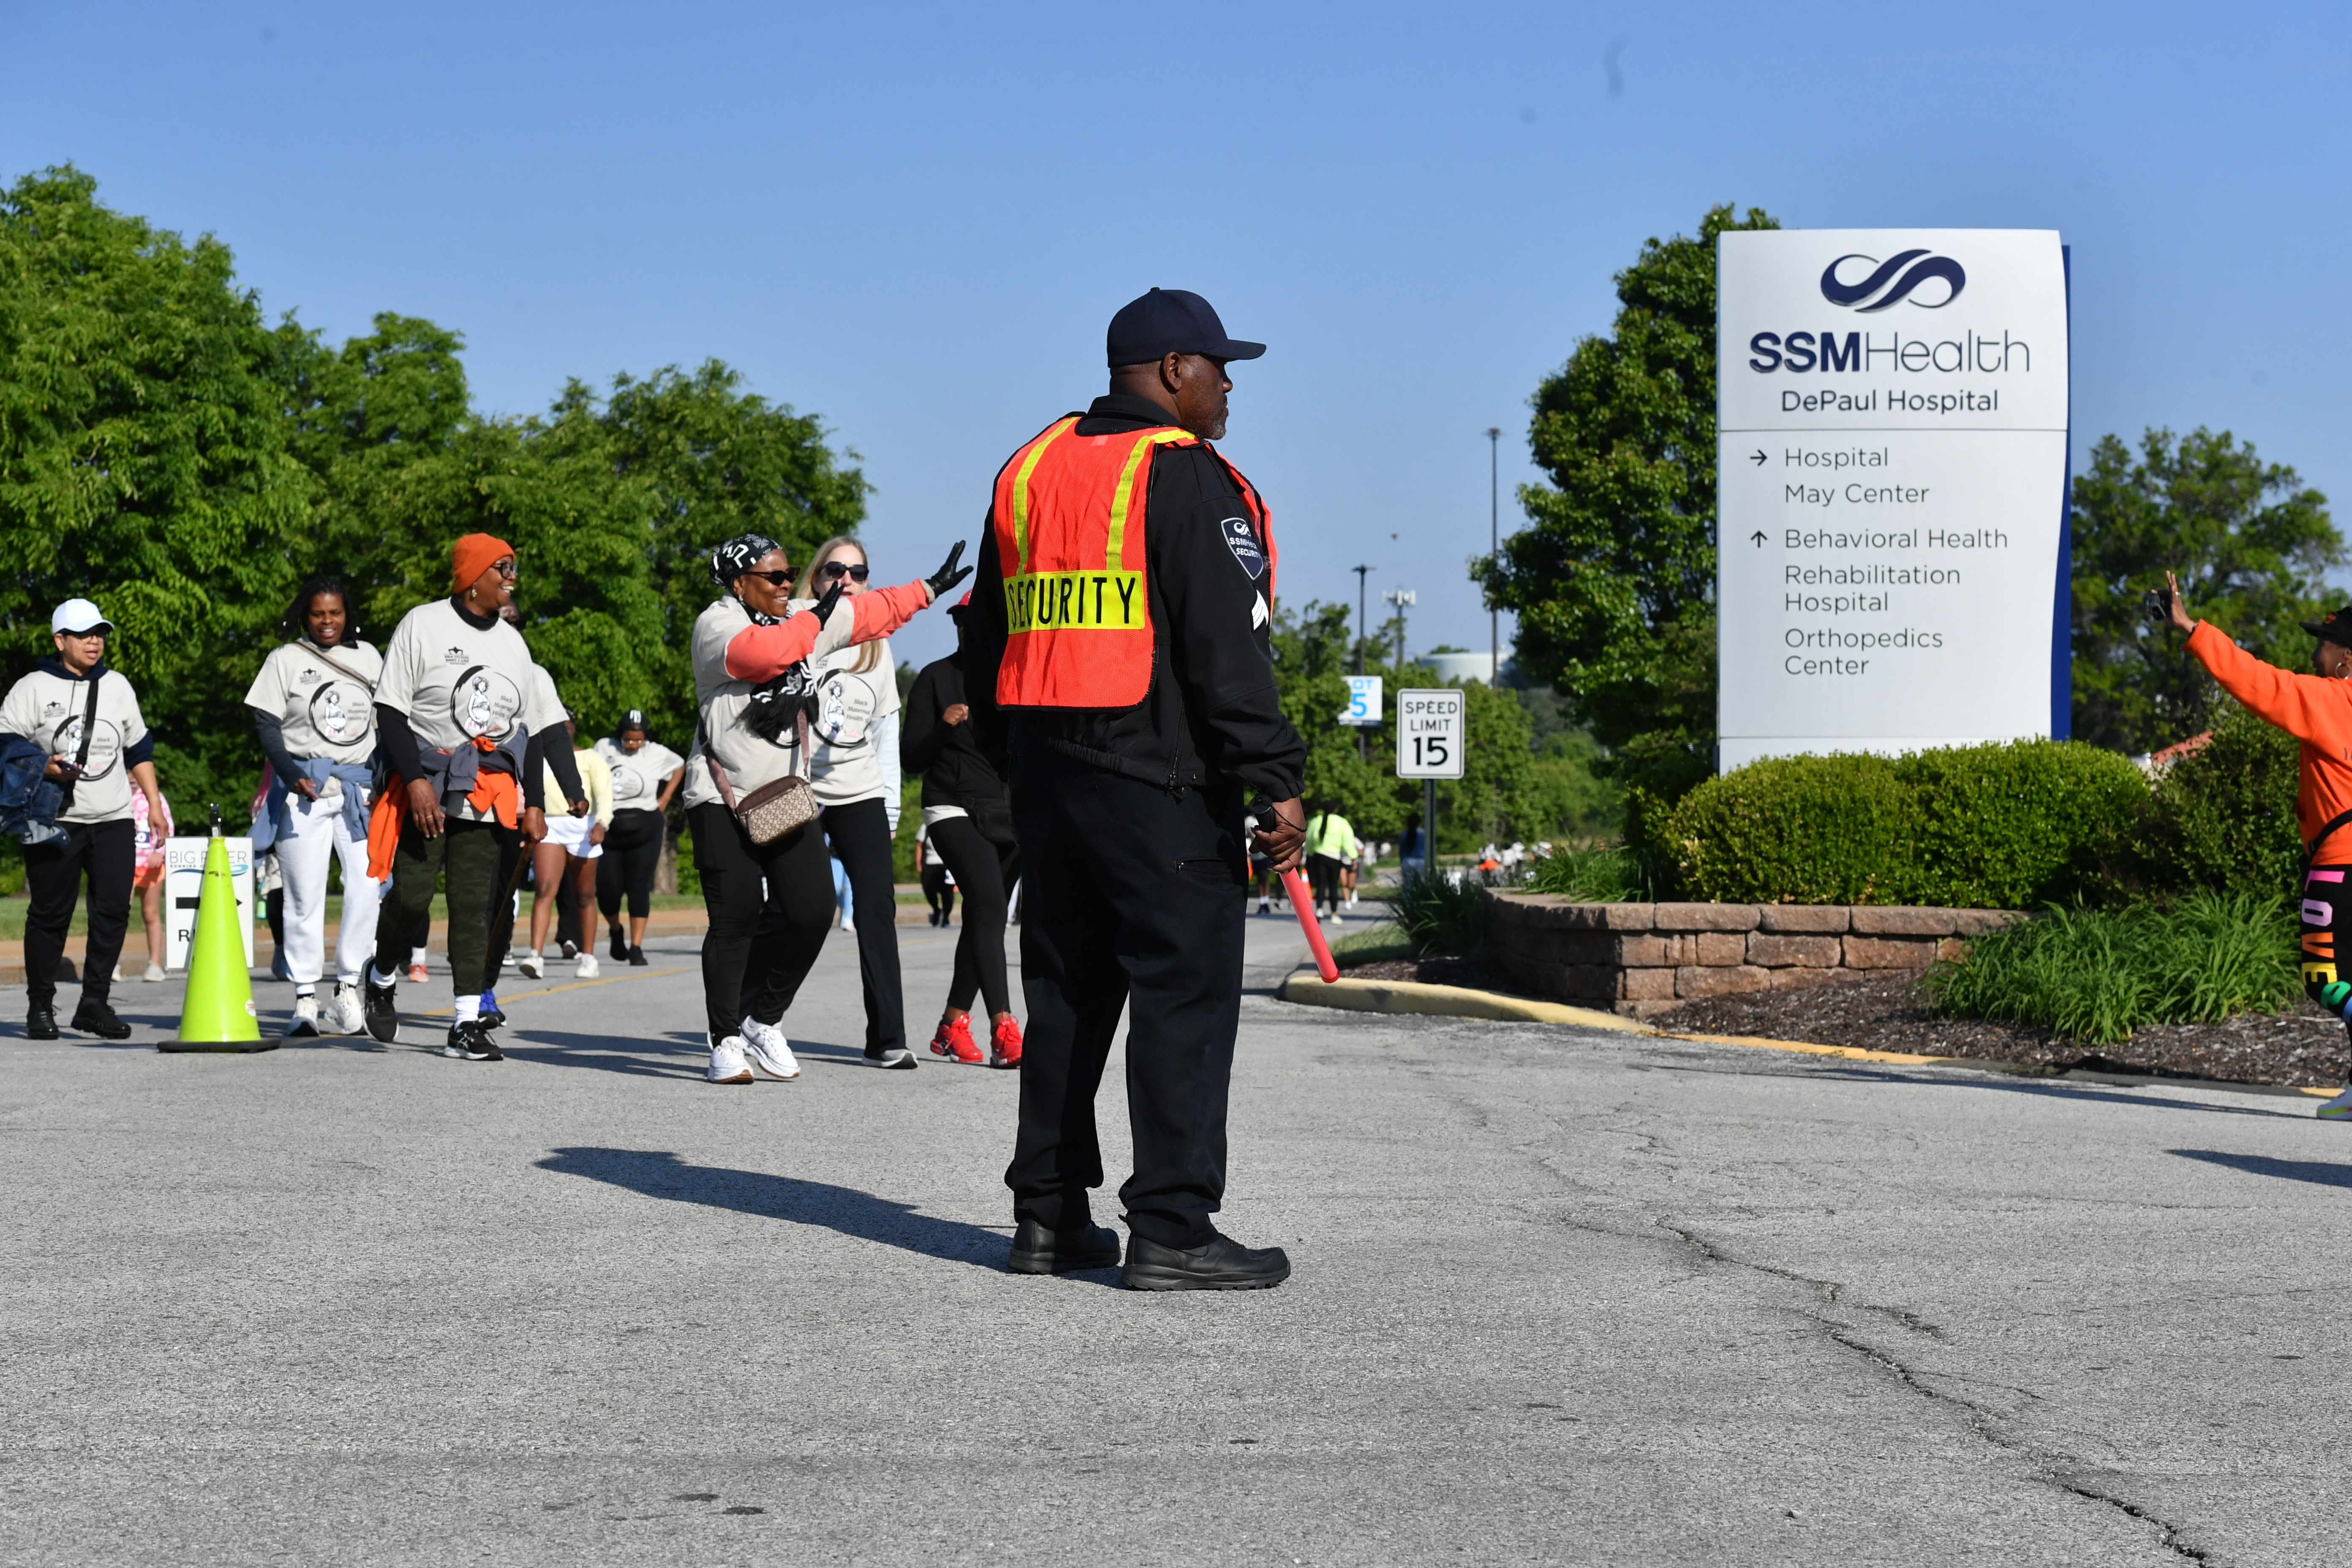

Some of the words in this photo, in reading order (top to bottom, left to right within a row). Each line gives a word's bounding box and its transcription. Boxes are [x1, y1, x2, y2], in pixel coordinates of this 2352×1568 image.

[1782, 390, 1876, 411] DePaul
[1888, 390, 1998, 415] Hospital
[1786, 447, 1888, 471] Hospital
[1786, 484, 1835, 507] May
[1845, 483, 1929, 503] Center
[1786, 529, 1917, 548] Behavioral
[1929, 529, 2007, 548] Health
[1236, 547, 1260, 559] SECURITY
[1786, 565, 1960, 585] Rehabilitation
[1008, 577, 1135, 628] SECURITY
[1786, 592, 1888, 615] Hospital
[1785, 628, 1942, 651] Orthopedics
[1785, 655, 1869, 675] Center
[1353, 679, 1373, 690] OT
[1351, 693, 1367, 717] 5
[1405, 701, 1457, 714] SPEED
[1410, 719, 1451, 732] LIMIT
[1413, 736, 1448, 768] 15
[170, 850, 195, 864] BIG
[201, 850, 247, 864] RER
[2302, 870, 2345, 986] LOVE
